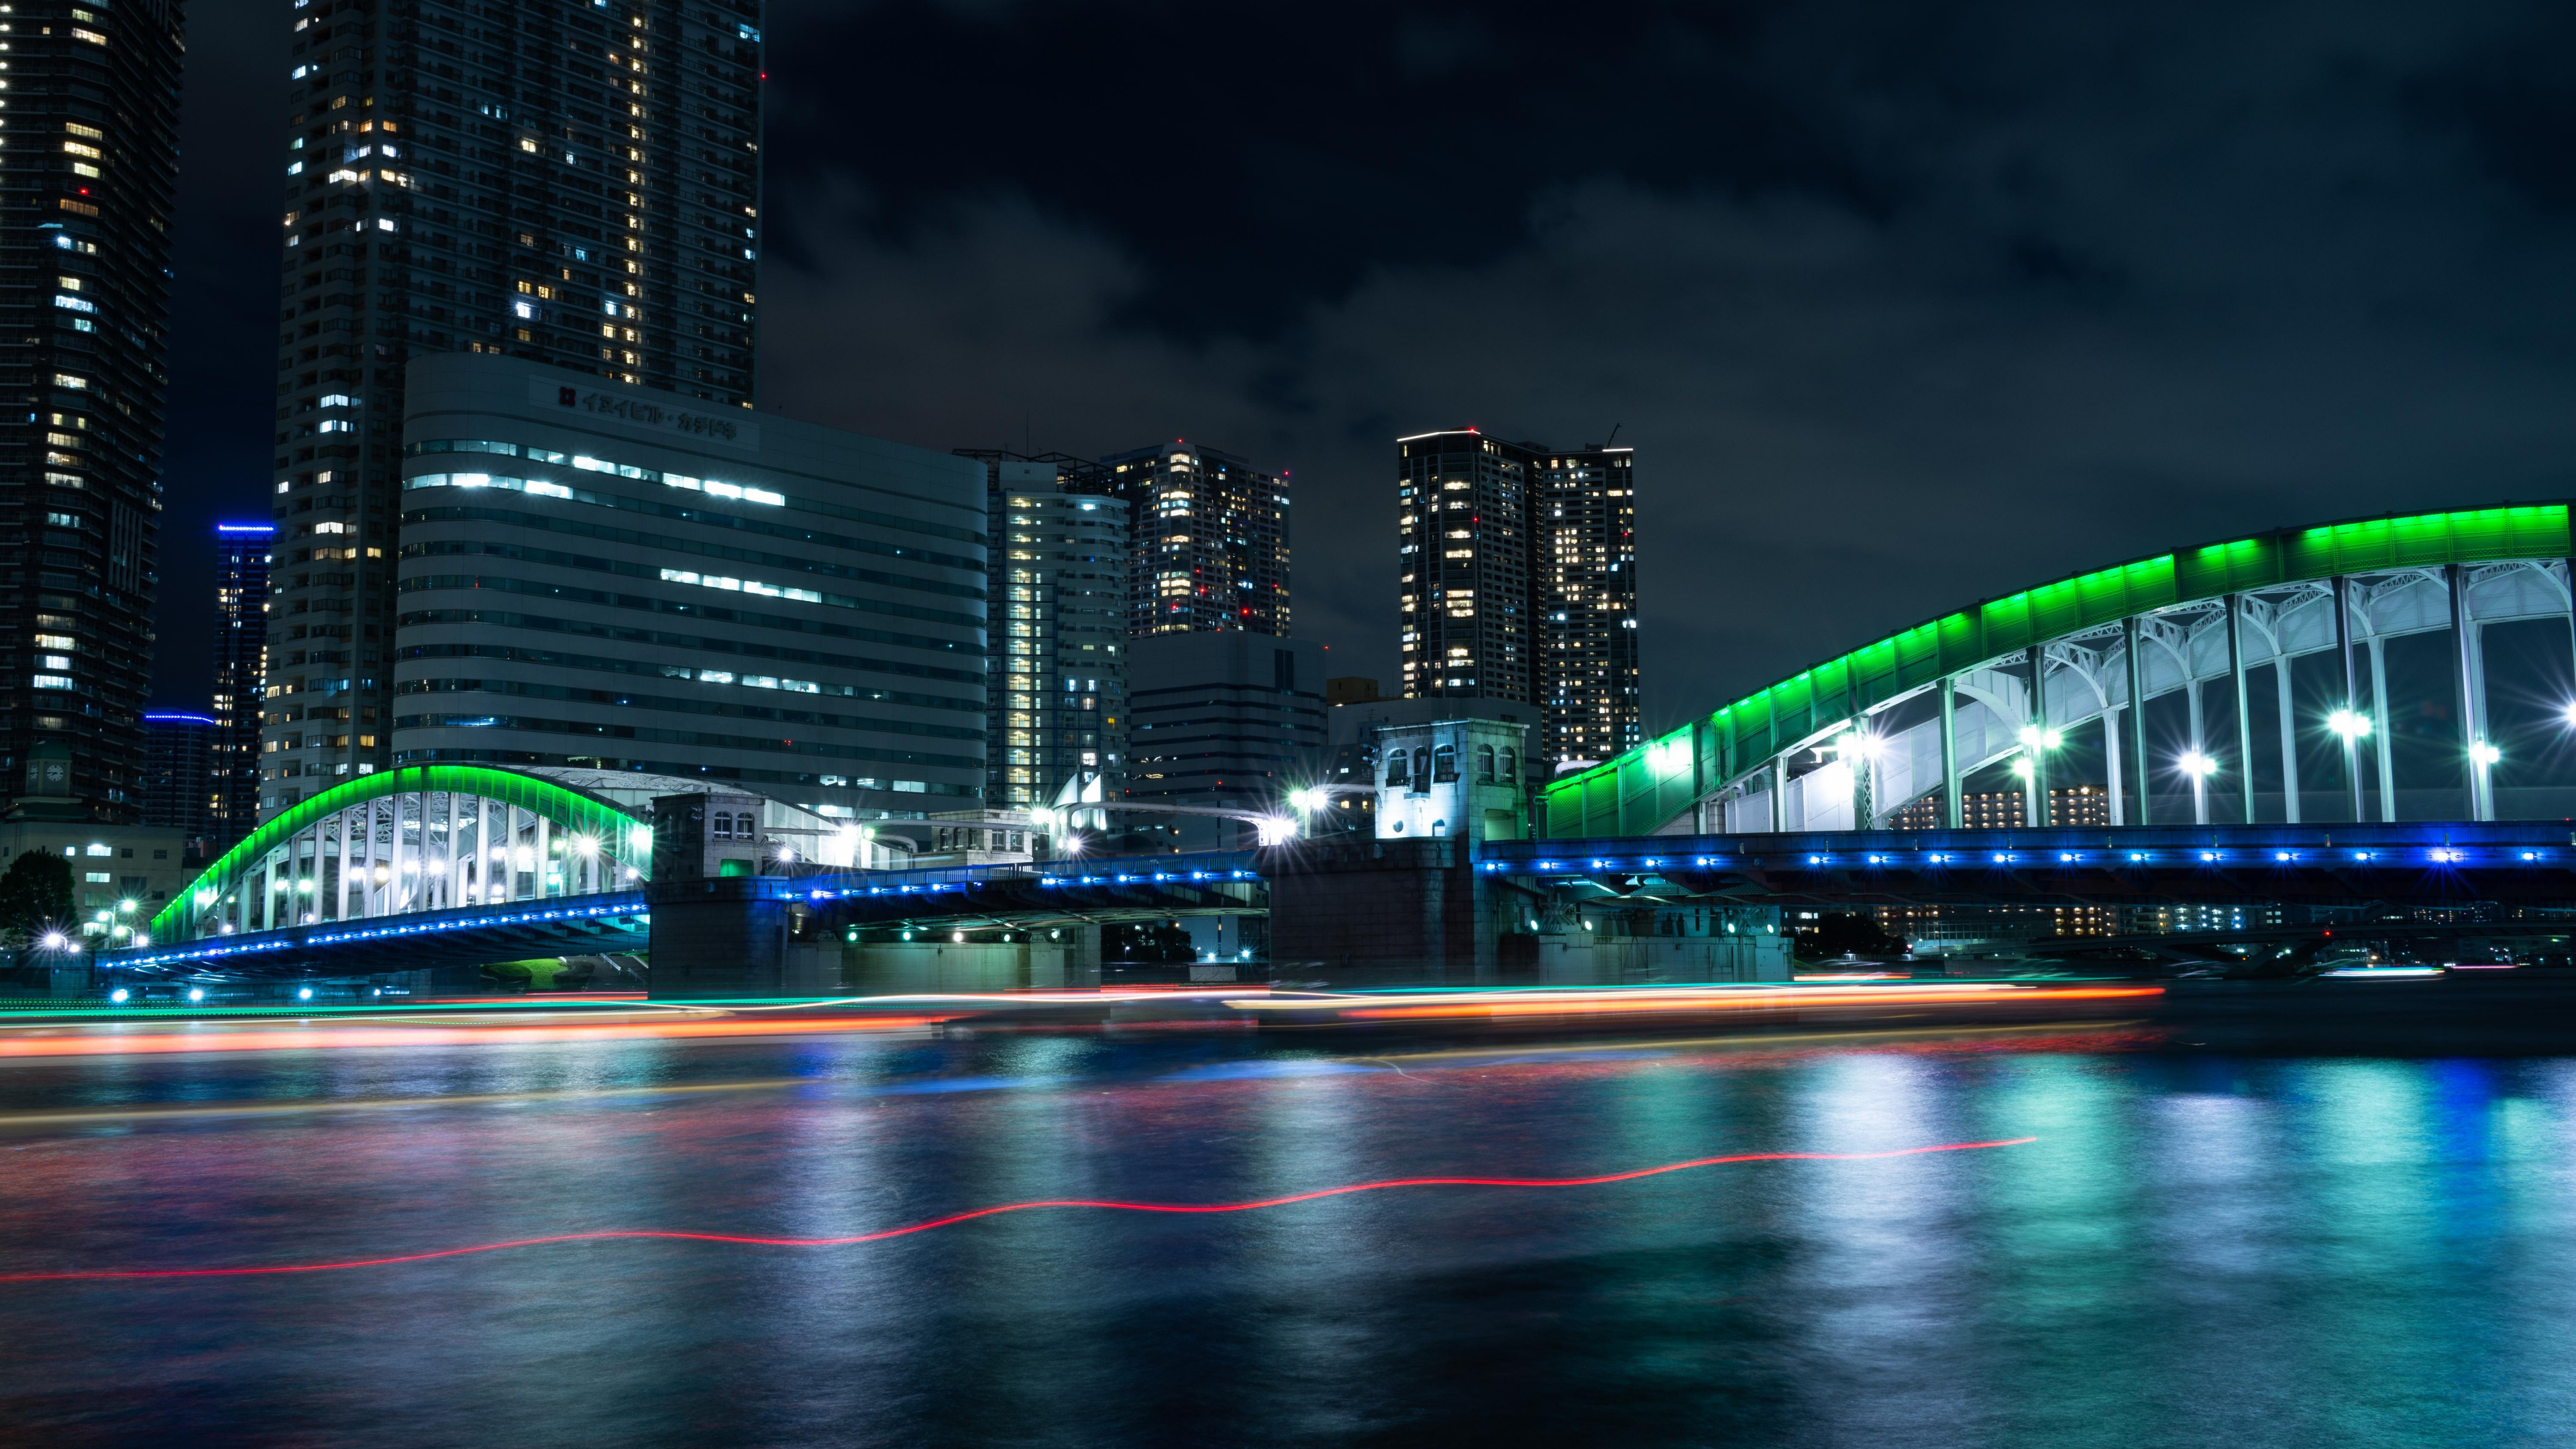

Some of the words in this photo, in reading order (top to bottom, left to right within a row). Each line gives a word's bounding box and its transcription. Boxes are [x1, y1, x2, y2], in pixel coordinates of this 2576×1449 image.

[583, 392, 737, 440] イヌイビル・カチドキ
